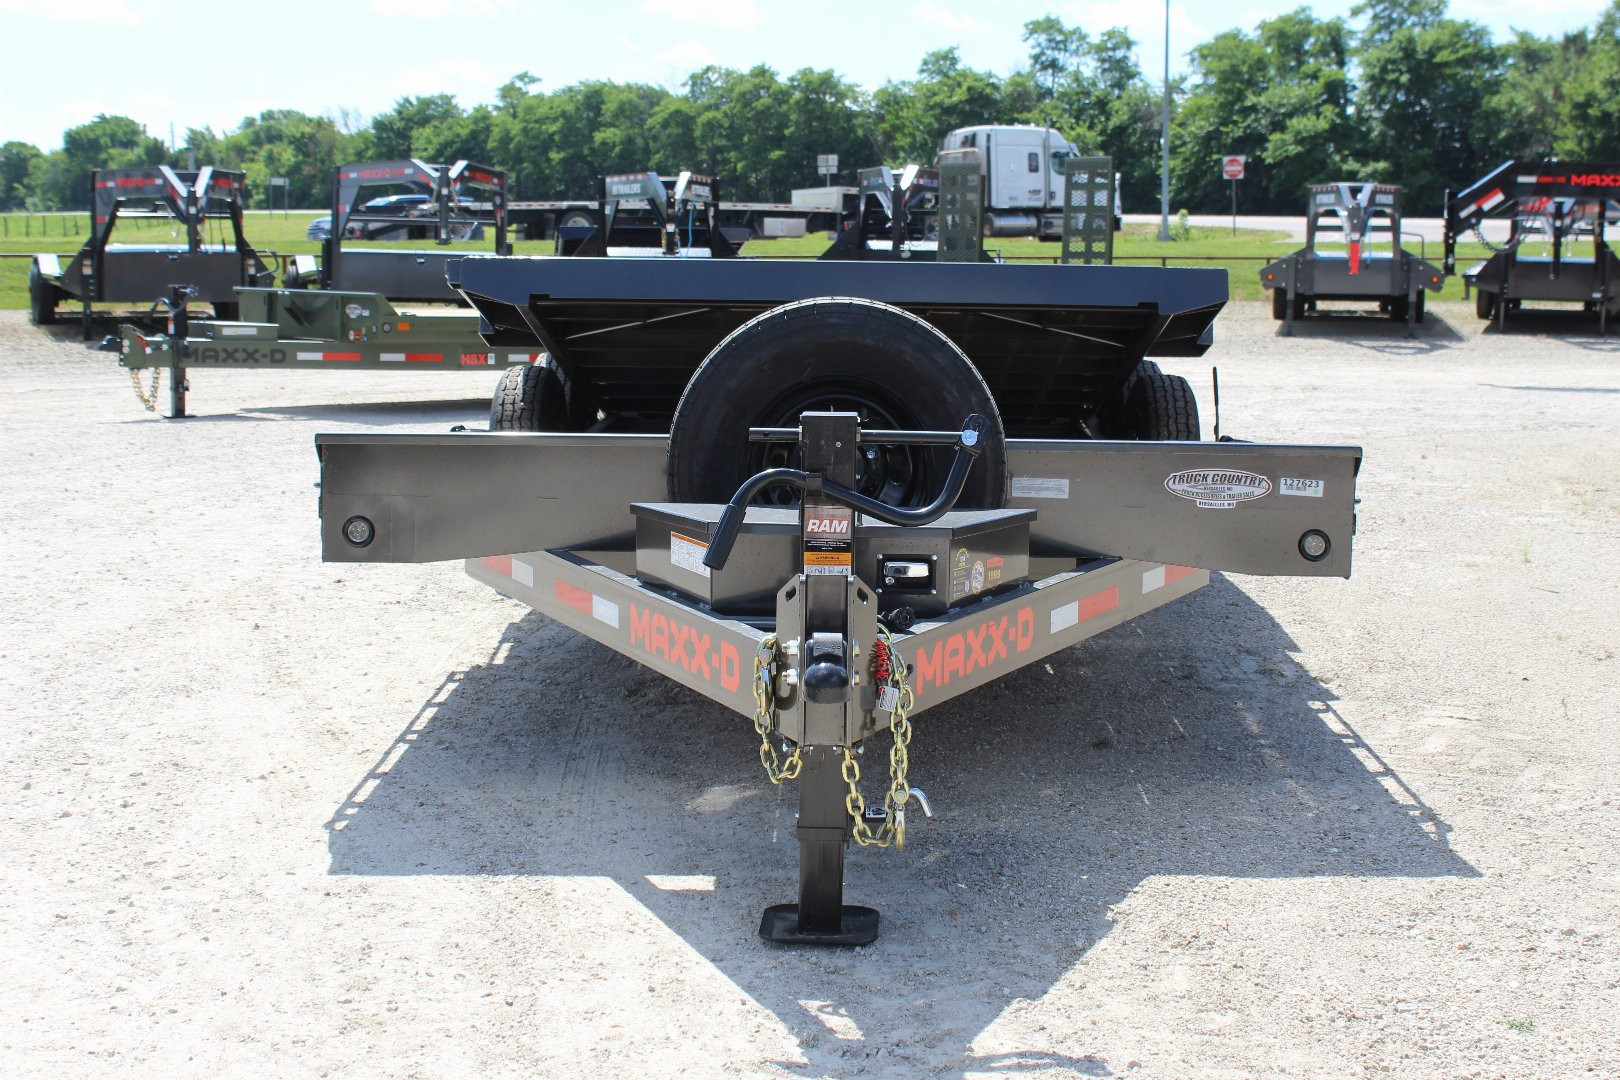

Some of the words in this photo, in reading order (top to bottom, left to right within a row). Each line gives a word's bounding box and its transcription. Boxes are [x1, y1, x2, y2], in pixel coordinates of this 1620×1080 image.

[461, 353, 486, 366] H8X
[1171, 473, 1209, 485] TRUCK
[1212, 473, 1265, 487] COUNTRY
[1283, 478, 1320, 488] 127623
[807, 519, 849, 534] RAM
[629, 601, 740, 693] MAXX-D
[916, 606, 1034, 697] MAXX-D
